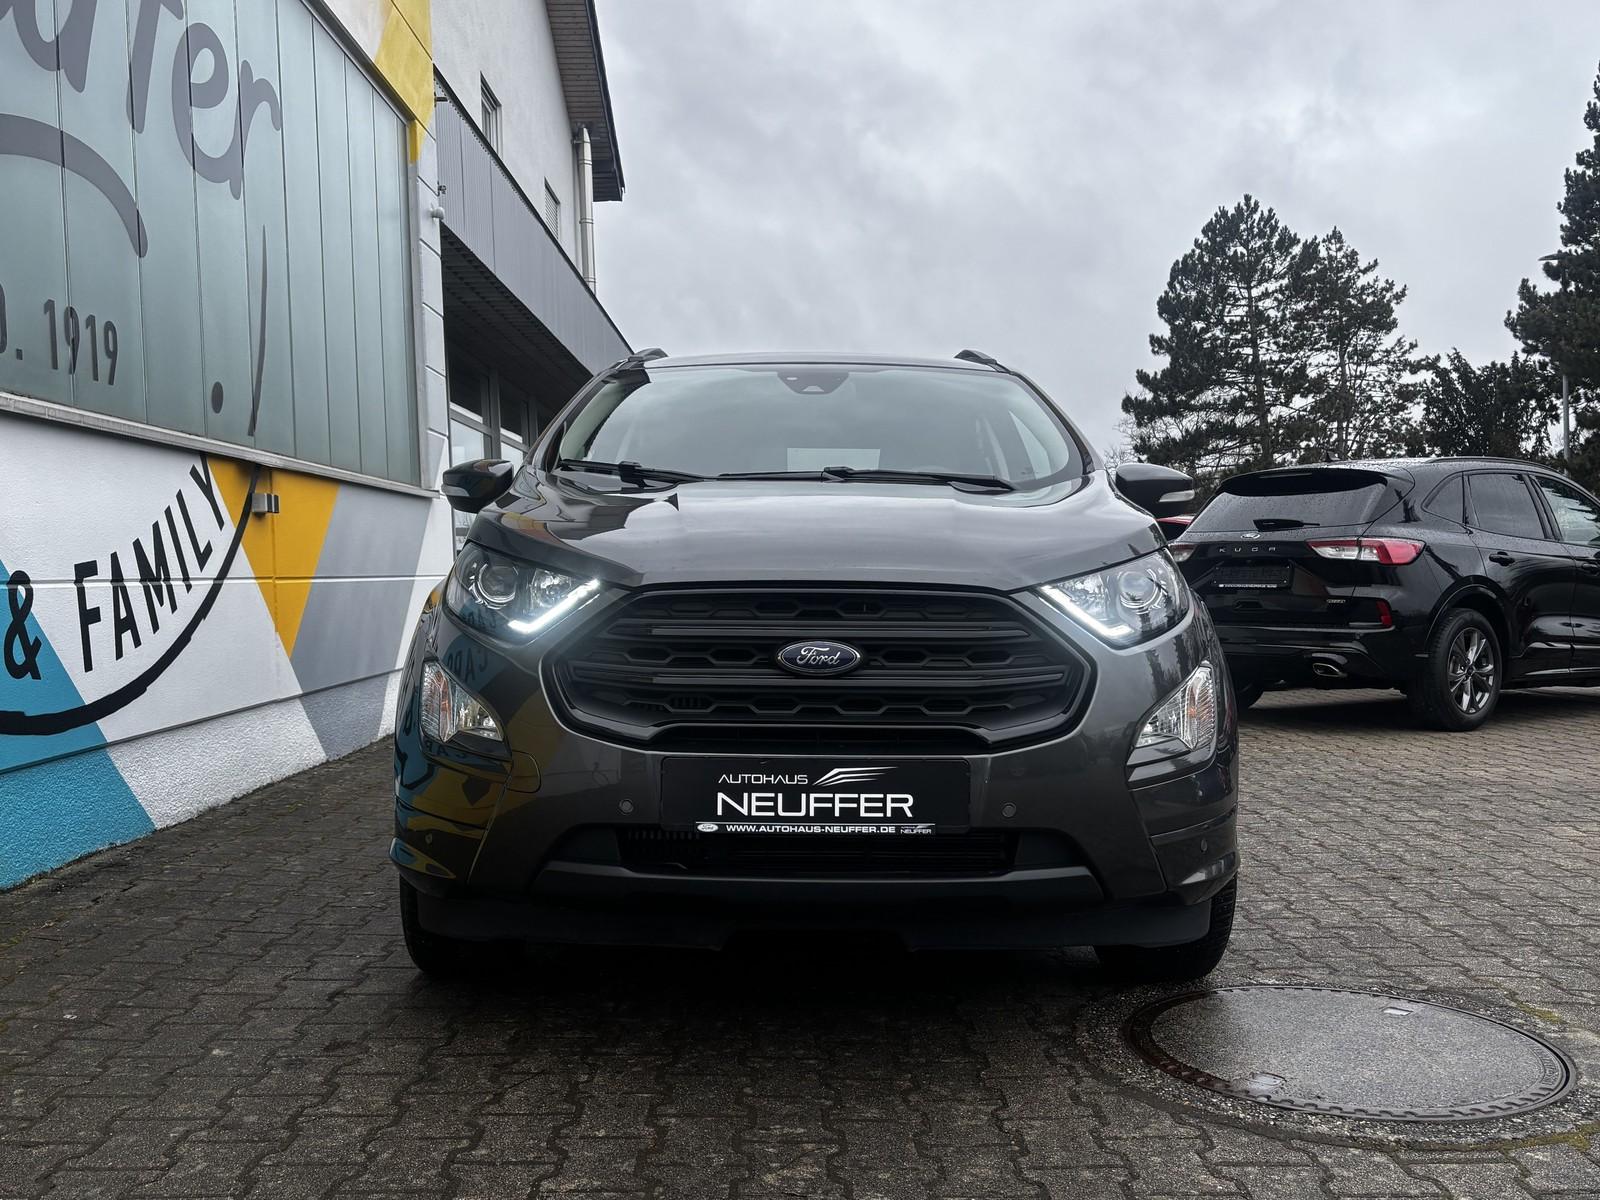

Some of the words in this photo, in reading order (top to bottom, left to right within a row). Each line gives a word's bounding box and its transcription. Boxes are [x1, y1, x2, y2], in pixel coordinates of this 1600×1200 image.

[43, 298, 118, 386] 1919
[4, 570, 42, 680] &
[74, 452, 225, 673] FAMILY
[796, 646, 841, 665] Ford
[718, 773, 809, 785] AUTOHAUS
[716, 792, 914, 818] NEUFFER
